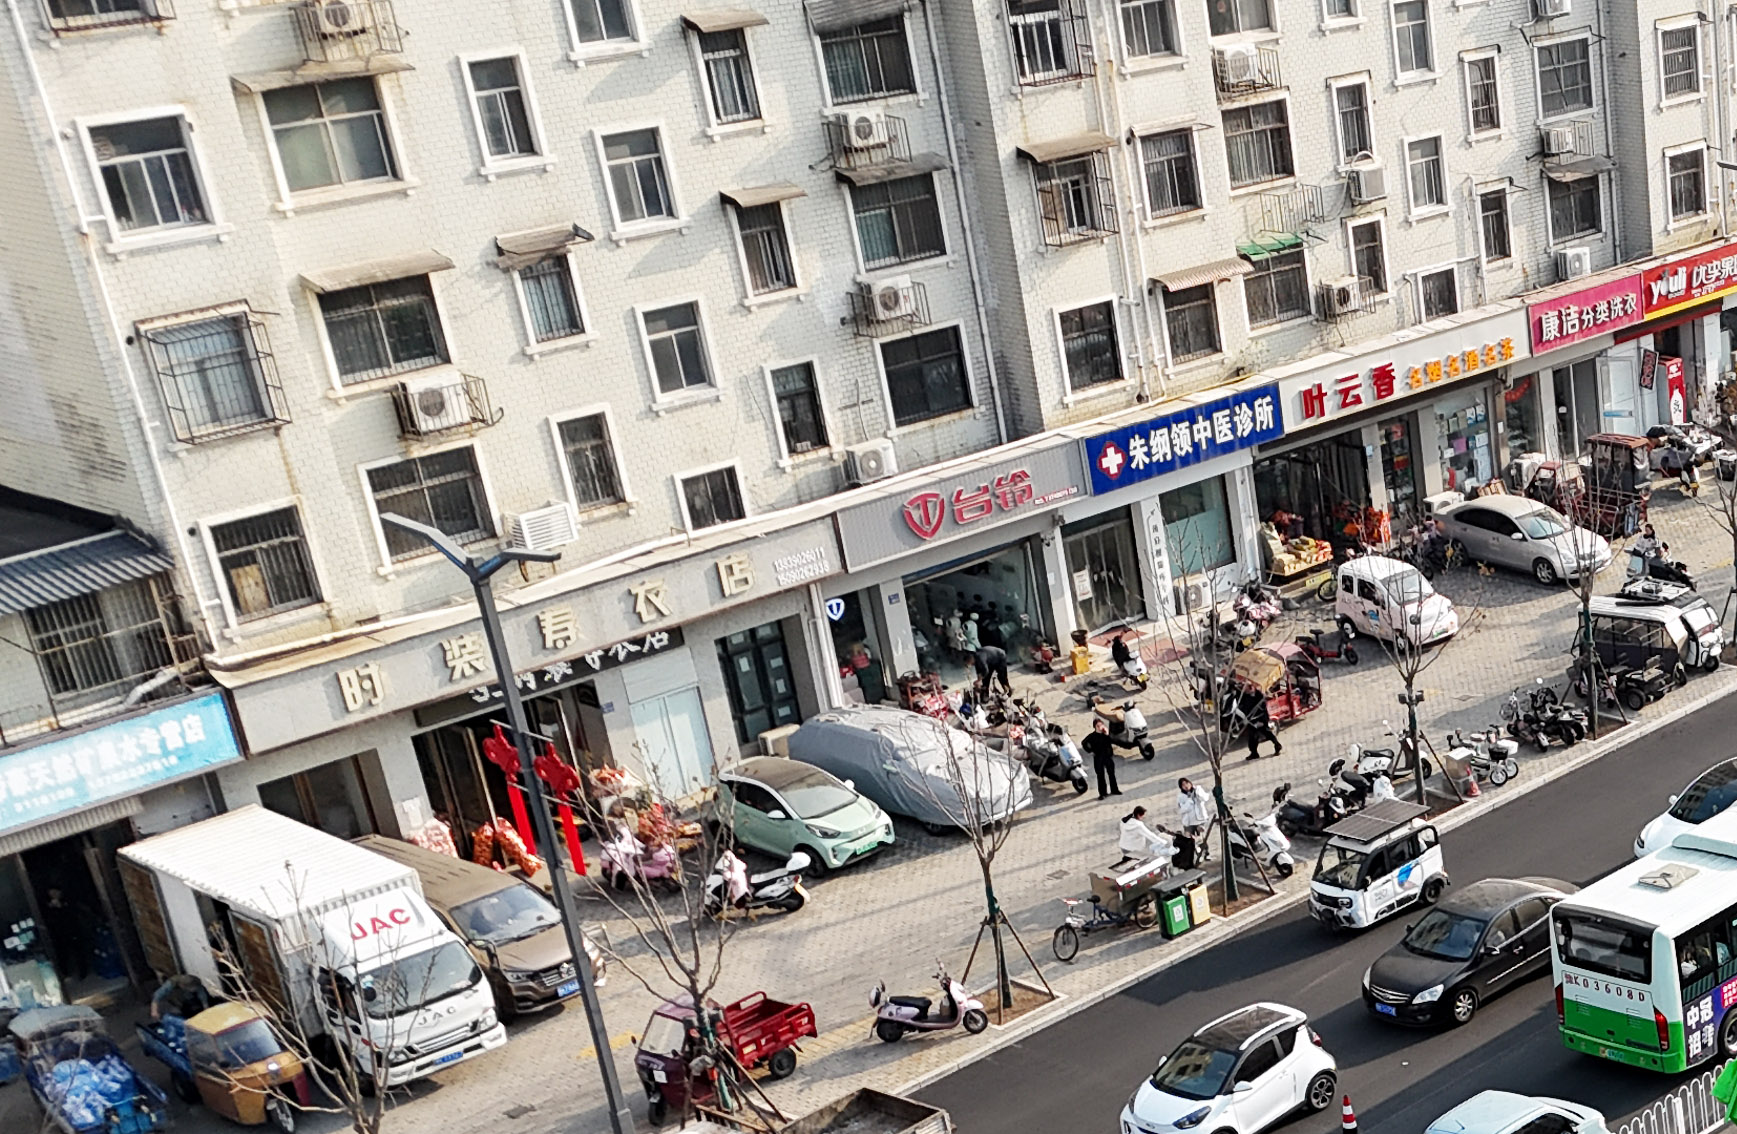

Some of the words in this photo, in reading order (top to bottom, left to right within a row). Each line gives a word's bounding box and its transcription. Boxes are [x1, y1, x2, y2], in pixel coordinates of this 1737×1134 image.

[1541, 292, 1638, 342] 康洁分类洗衣
[1300, 361, 1396, 420] 叶云香
[1408, 336, 1515, 390] 名烟名酒名茶
[1128, 394, 1274, 471] 朱纲领中医诊所
[952, 468, 1033, 525] 台铃
[351, 907, 412, 941] JAC
[416, 1004, 457, 1027] JAC
[1686, 995, 1714, 1030] 中冠
